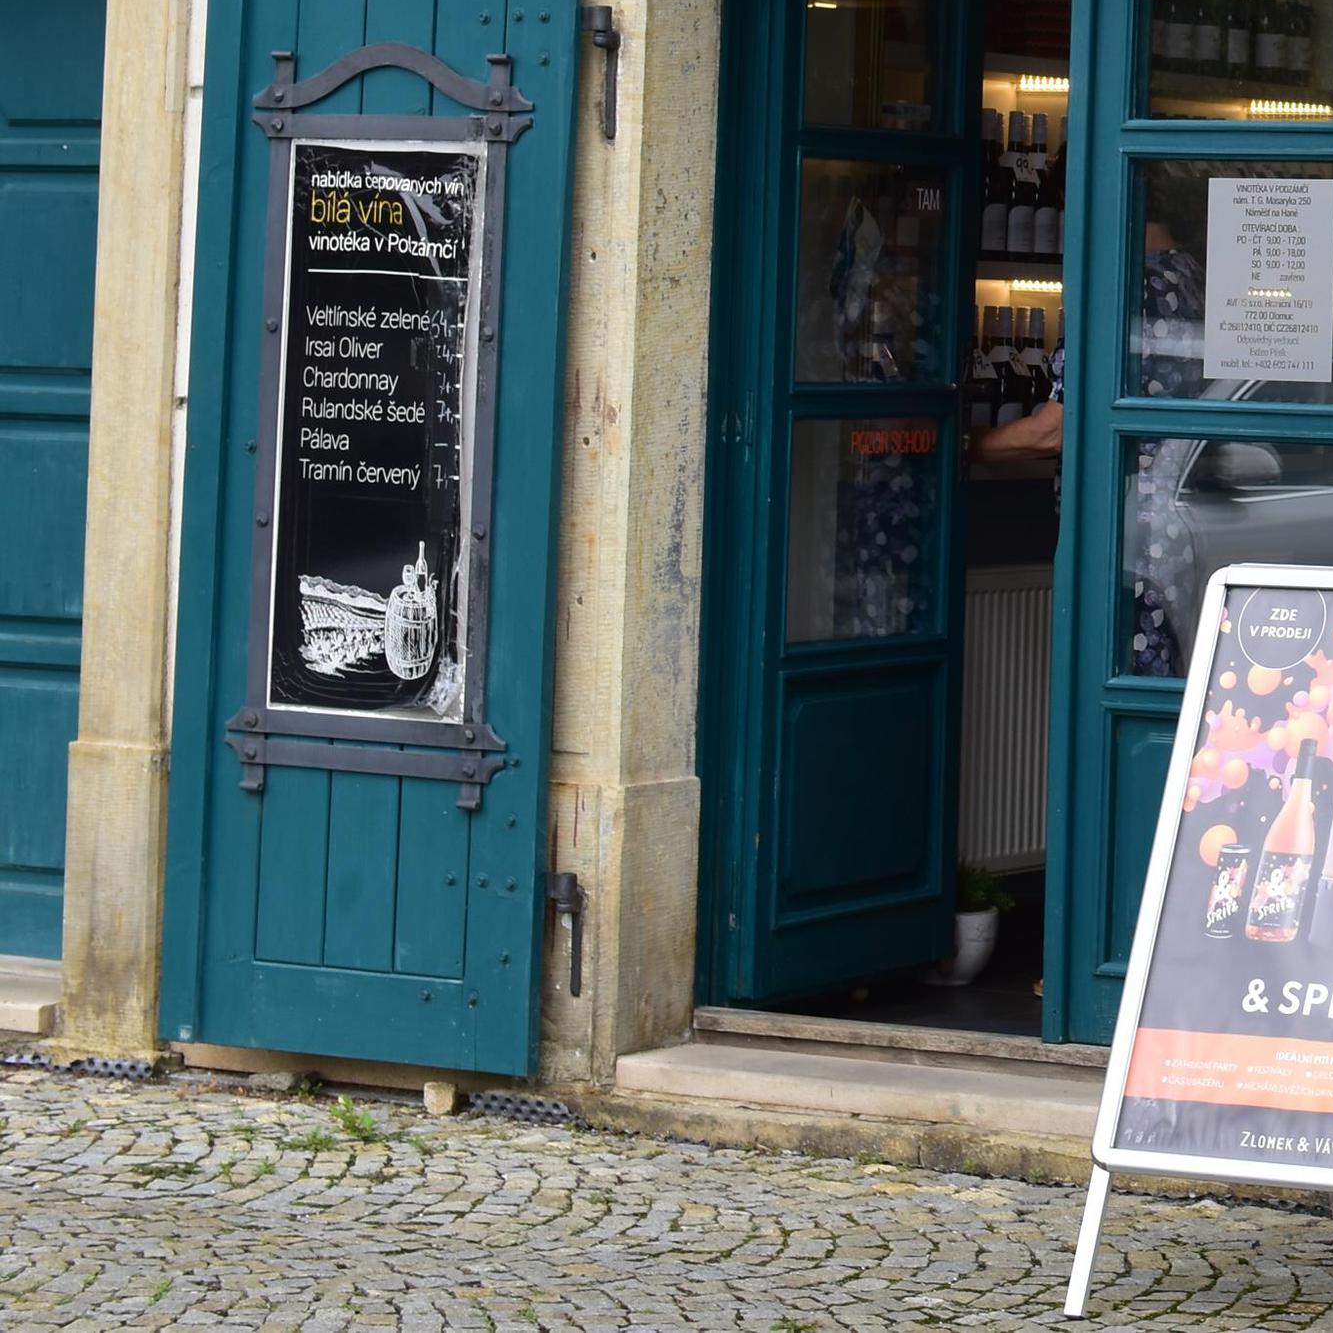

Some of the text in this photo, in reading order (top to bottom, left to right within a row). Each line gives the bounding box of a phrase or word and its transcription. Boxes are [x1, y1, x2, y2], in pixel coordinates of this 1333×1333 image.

[311, 170, 362, 189] nabídka
[365, 172, 442, 197] čepovaných
[310, 190, 403, 225] bílá vína
[916, 188, 940, 211] TAM
[308, 230, 370, 252] vinotéka
[374, 238, 384, 252] v
[306, 305, 430, 332] Veltlínské zelené
[305, 336, 384, 360] Irsai Oliver
[303, 366, 399, 396] Chardonnay
[302, 396, 426, 424] Rulandské šedé
[300, 427, 350, 451] Pálava
[299, 458, 421, 491] Tramín červený
[1269, 608, 1298, 622] ZDE
[1249, 625, 1312, 639] V PRODEJI
[1242, 978, 1269, 1013] &
[1240, 1131, 1294, 1151] ZLOMEK
[1297, 1136, 1310, 1152] &
